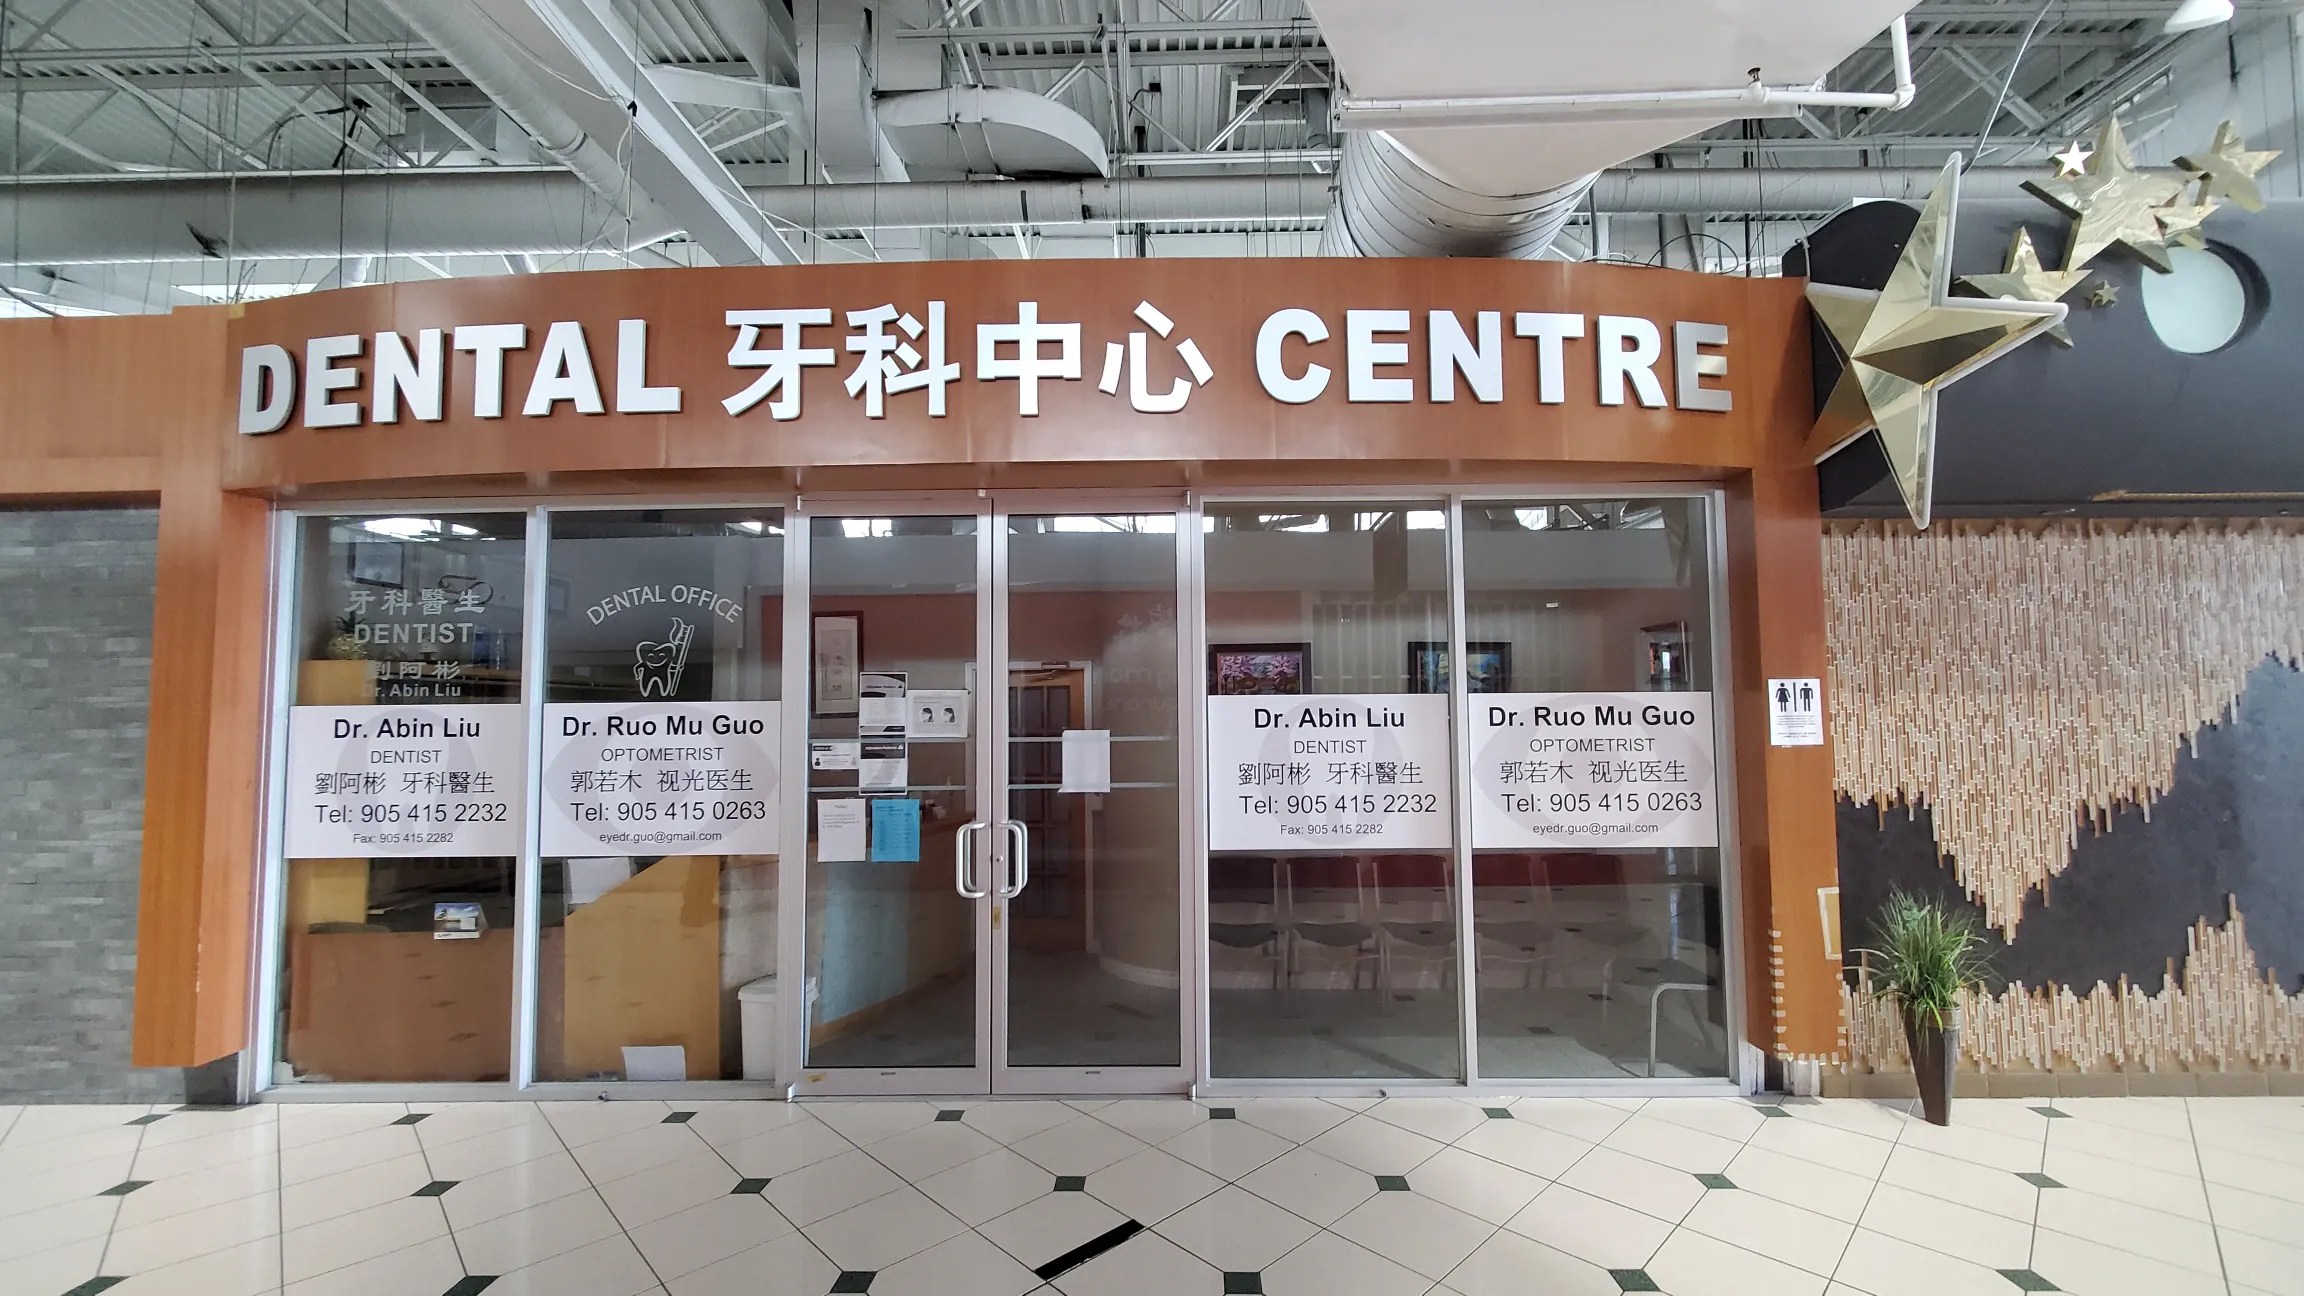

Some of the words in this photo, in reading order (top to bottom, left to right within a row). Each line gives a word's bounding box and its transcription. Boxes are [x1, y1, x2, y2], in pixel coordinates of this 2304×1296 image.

[239, 319, 681, 435] DENTAL
[721, 300, 1214, 420] 牙科中心
[1255, 308, 1733, 412] CENTRE
[344, 588, 486, 616] 牙科醫生
[586, 585, 666, 625] DENTAL
[671, 584, 743, 623] OFFICE
[354, 622, 474, 644] DENTIST
[389, 683, 429, 697] Abin
[434, 683, 461, 697] Liu
[563, 717, 597, 736] Dr.
[608, 716, 656, 735] Ruo
[667, 716, 702, 735] Mu
[712, 715, 764, 734] Guo
[1254, 709, 1289, 728] Dr.
[1299, 708, 1356, 728] Abin
[1367, 708, 1404, 727] Liu
[1489, 707, 1524, 726] Dr.
[1535, 706, 1585, 726] Ruo
[1595, 706, 1632, 725] Mu
[1642, 706, 1695, 725] Guo
[334, 719, 367, 739] Dr.
[377, 718, 433, 738] Abin
[444, 718, 480, 737] Liu
[602, 748, 723, 761] OPTOMETRIST
[1294, 740, 1367, 754] DENTIST
[1530, 739, 1655, 752] OPTOMETRIST
[371, 750, 442, 763] DENTIST
[571, 770, 642, 793] 郭若木
[656, 769, 753, 792] 视光医生
[1239, 762, 1310, 786] 劉阿彬
[1326, 762, 1423, 785] 牙科醫生
[1500, 761, 1573, 783] 郭若木
[1589, 760, 1688, 783] 视光医生
[315, 772, 386, 795] 劉阿彬
[400, 771, 495, 794] 牙科醫生
[571, 802, 609, 821] Tel:
[617, 802, 657, 820] 905
[665, 802, 705, 820] 415
[713, 801, 766, 819] 0263
[1239, 795, 1278, 814] Tel:
[1287, 795, 1326, 813] 905
[1335, 795, 1375, 813] 415
[1383, 795, 1436, 812] 2232
[1501, 794, 1541, 812] Tel:
[1550, 793, 1590, 812] 905
[1599, 793, 1639, 811] 415
[1647, 792, 1702, 811] 0263
[315, 805, 352, 823] Tel:
[361, 805, 400, 822] 905
[408, 804, 447, 822] 415
[454, 803, 507, 821] 2232
[353, 834, 376, 843] Fax:
[380, 834, 400, 843] 905
[403, 833, 423, 842] 415
[426, 833, 453, 842] 2282
[600, 831, 722, 843] eyedr.guo@gmail.com
[1281, 825, 1304, 834] Fax:
[1308, 825, 1328, 834] 905
[1332, 824, 1352, 834] 415
[1356, 824, 1383, 834] 2282
[1533, 823, 1658, 835] eyedr.guo@gmail.com
